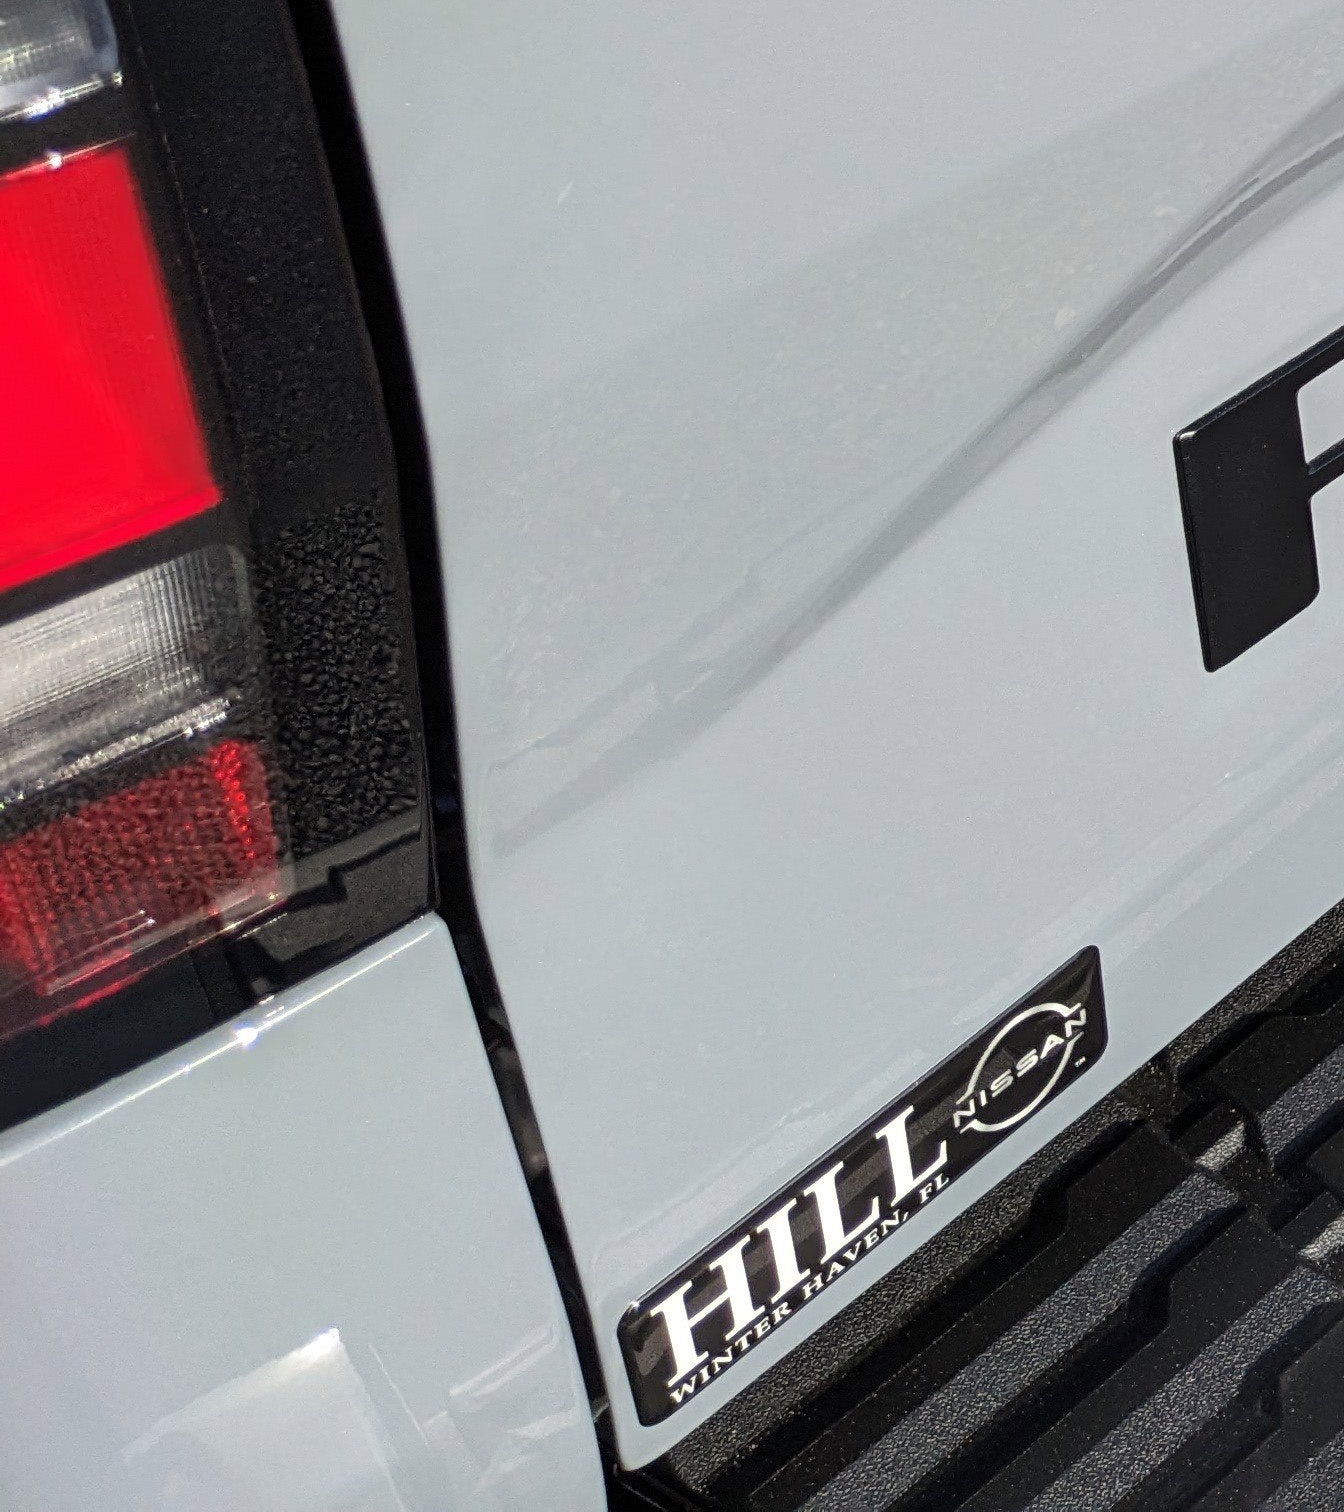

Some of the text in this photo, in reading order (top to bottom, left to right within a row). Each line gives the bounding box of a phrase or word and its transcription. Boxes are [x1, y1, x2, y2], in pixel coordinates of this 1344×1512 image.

[954, 1007, 1087, 1129] NISSAN
[651, 1105, 948, 1386] HILL
[670, 1174, 950, 1404] WINTER HAVEN, FL
